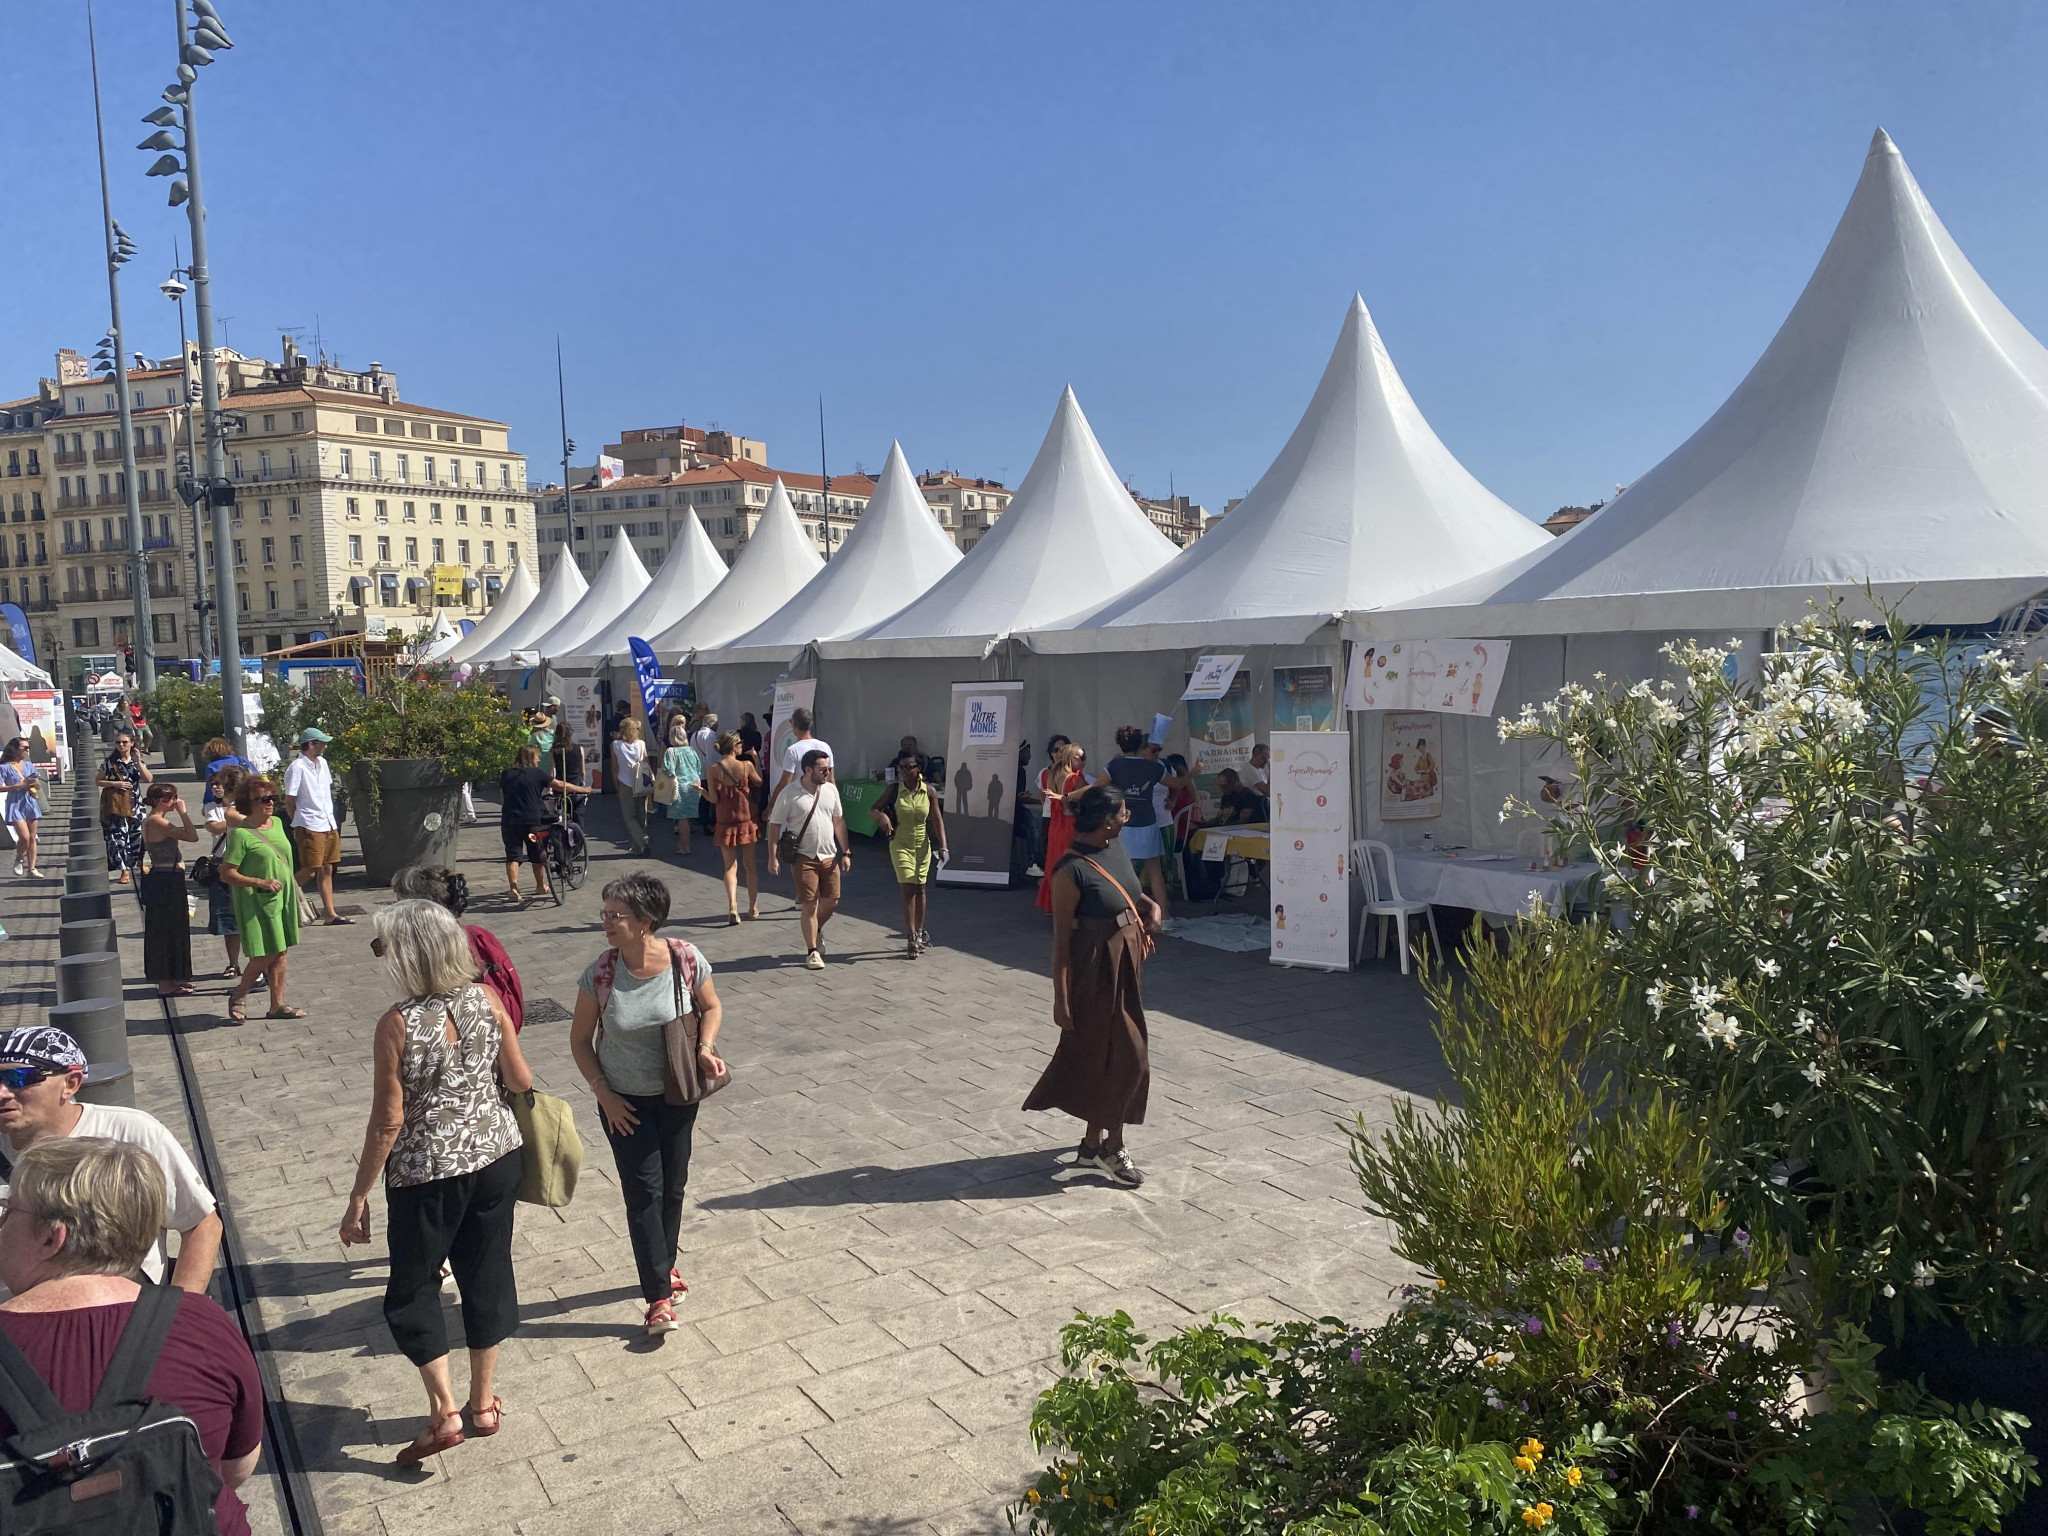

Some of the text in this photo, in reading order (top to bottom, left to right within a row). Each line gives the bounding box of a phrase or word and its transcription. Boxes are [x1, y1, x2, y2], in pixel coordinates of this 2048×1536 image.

[777, 693, 794, 702] VMEH
[971, 702, 982, 713] UN
[971, 712, 996, 722] AUTRE
[970, 722, 997, 733] MONDE
